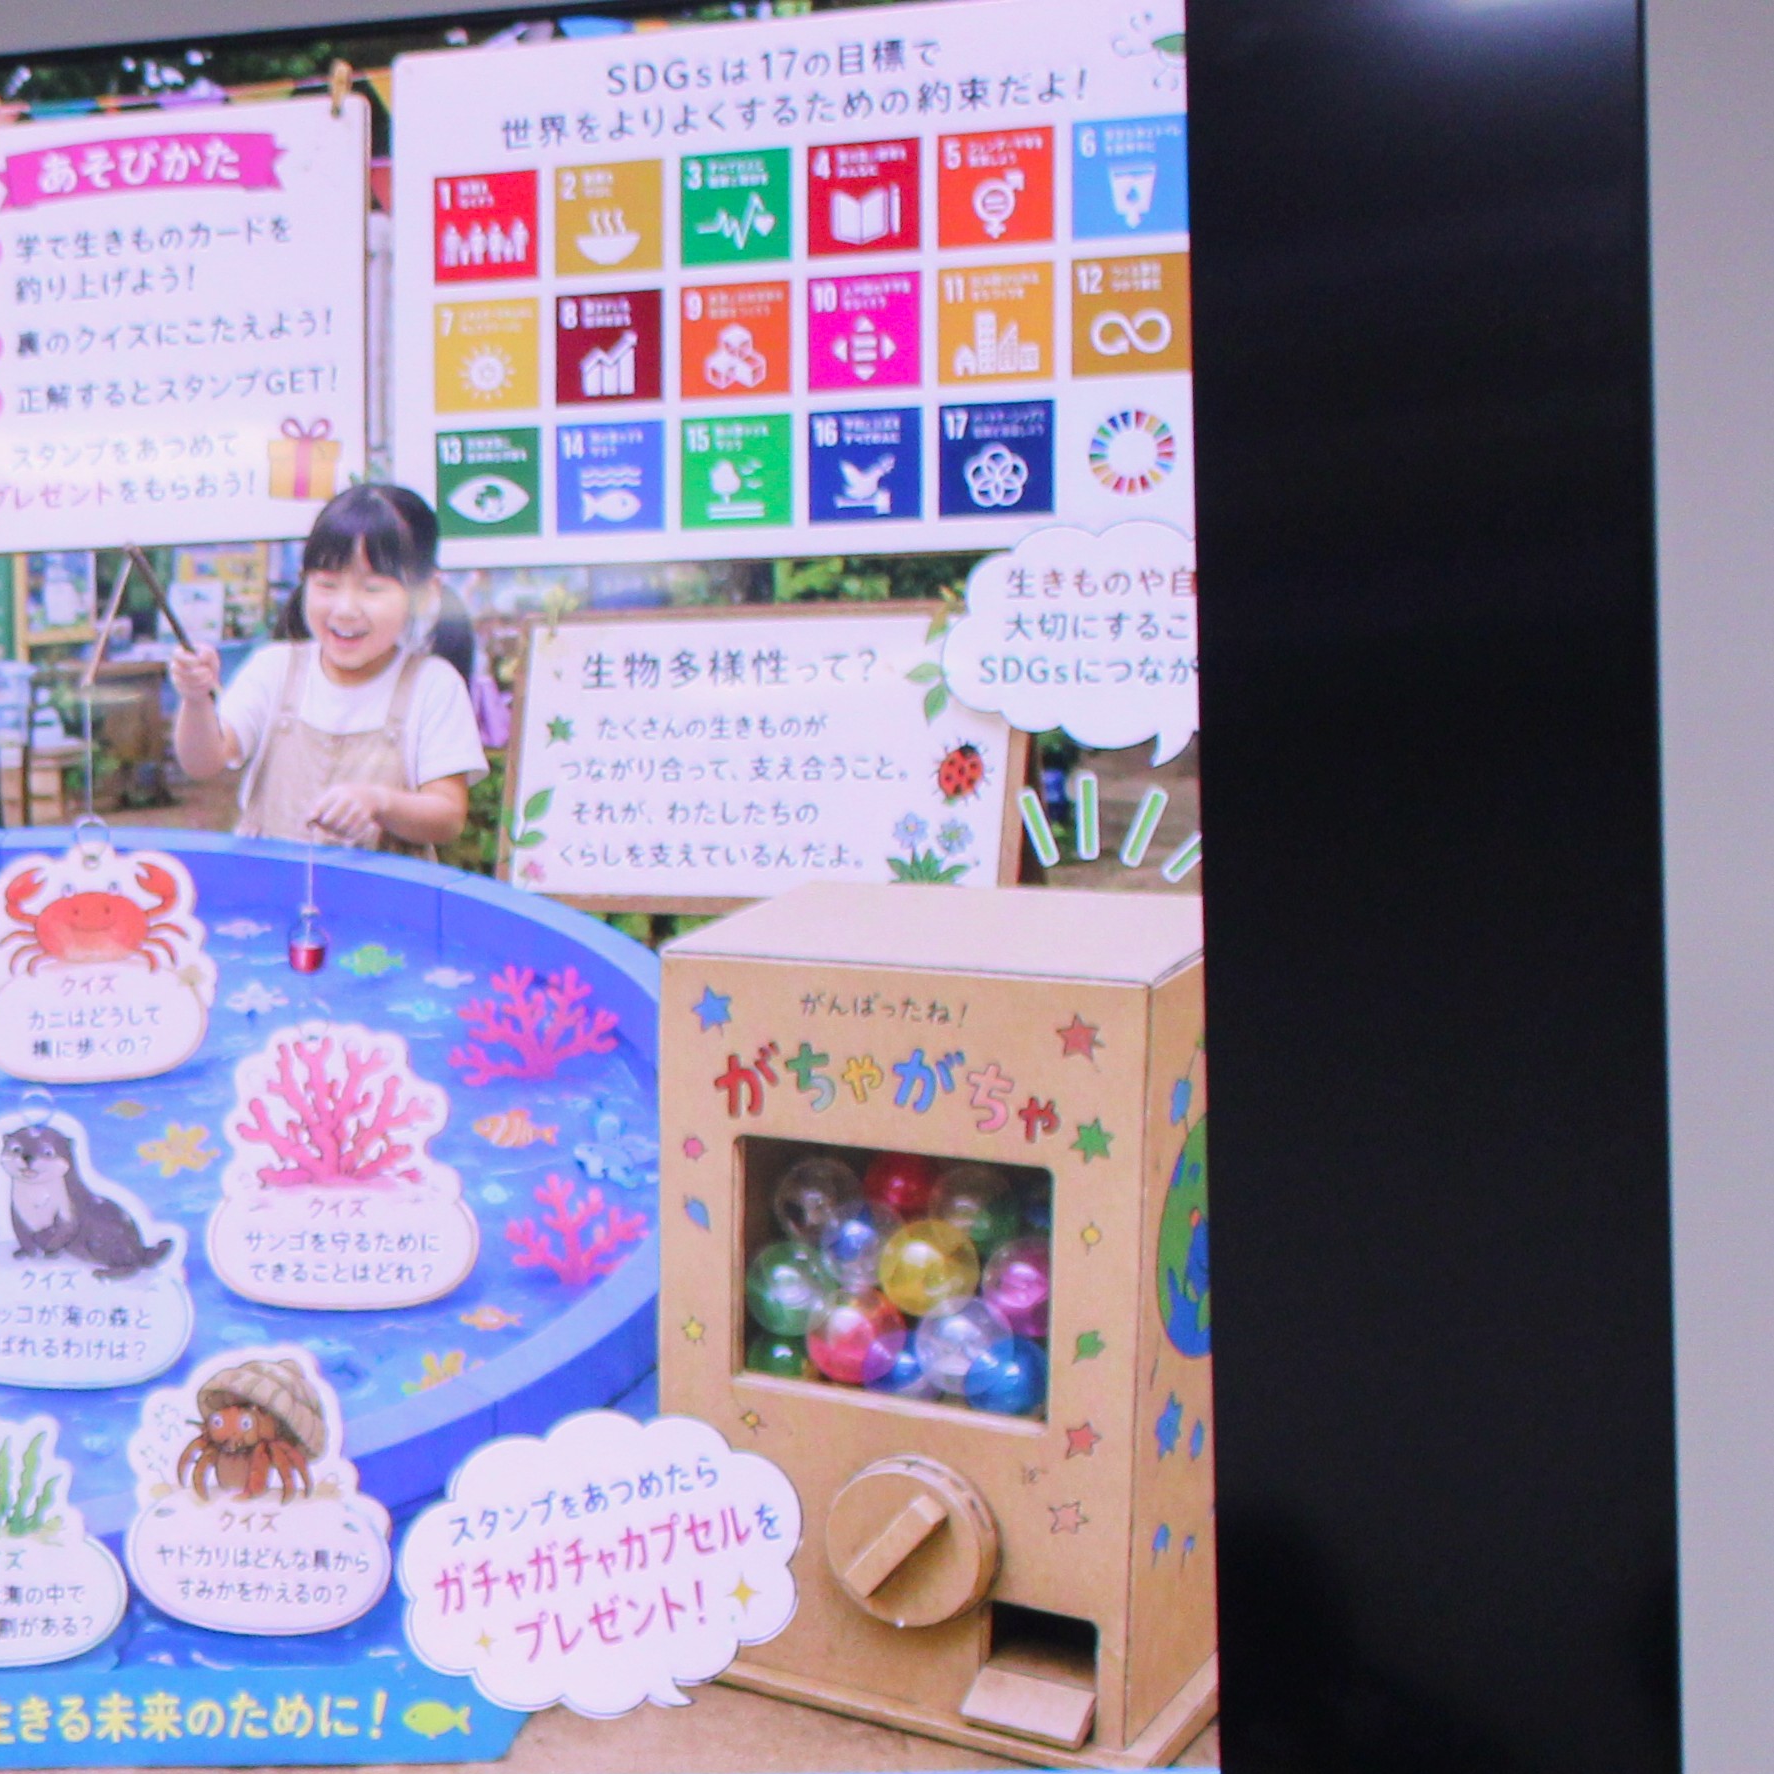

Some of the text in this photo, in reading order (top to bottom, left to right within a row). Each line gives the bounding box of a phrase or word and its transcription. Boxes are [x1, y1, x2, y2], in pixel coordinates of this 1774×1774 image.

[606, 38, 943, 98] SDGsは17の目標で
[501, 69, 1090, 151] 世界をよりよくするための約束だよ！
[944, 139, 961, 169] 5
[1079, 128, 1096, 158] 6
[37, 140, 242, 194] あそびかた
[686, 160, 702, 190] 3
[813, 151, 831, 180] 4
[438, 181, 452, 211] 1
[561, 171, 577, 200] 2
[944, 275, 965, 304] 11
[1076, 265, 1103, 295] 12
[684, 291, 702, 321] 9
[812, 284, 837, 313] 10
[440, 307, 454, 337] 7
[560, 299, 578, 330] 8
[685, 423, 710, 453] 15
[813, 416, 839, 447] 16
[944, 409, 968, 440] 17
[438, 436, 463, 465] 13
[562, 429, 585, 460] 14
[1007, 567, 1197, 598] 生きものや自
[1005, 611, 1190, 642] 大切にするこ
[581, 648, 879, 692] 生物多様性って？
[595, 713, 829, 742] たくさんの生きものが
[558, 755, 911, 782] つながり合って、支え合うこと。
[569, 799, 820, 827] それが、わたしたちの
[558, 842, 865, 872] くらしを支えているんだよ。
[59, 973, 119, 997] クイズ
[27, 1004, 162, 1031] カニはどうして
[797, 991, 969, 1029] がんばったね！
[715, 1042, 1061, 1143] がちゃがちゃ
[308, 1196, 370, 1219] クイズ
[244, 1230, 441, 1254] サンゴを守るために
[19, 1269, 81, 1291] クイズ
[450, 1456, 720, 1546] スタンプをあつめたら
[218, 1509, 282, 1533] クイズ
[434, 1503, 783, 1616] ガチャガチャカプセルを
[515, 1578, 707, 1662] プレゼント！
